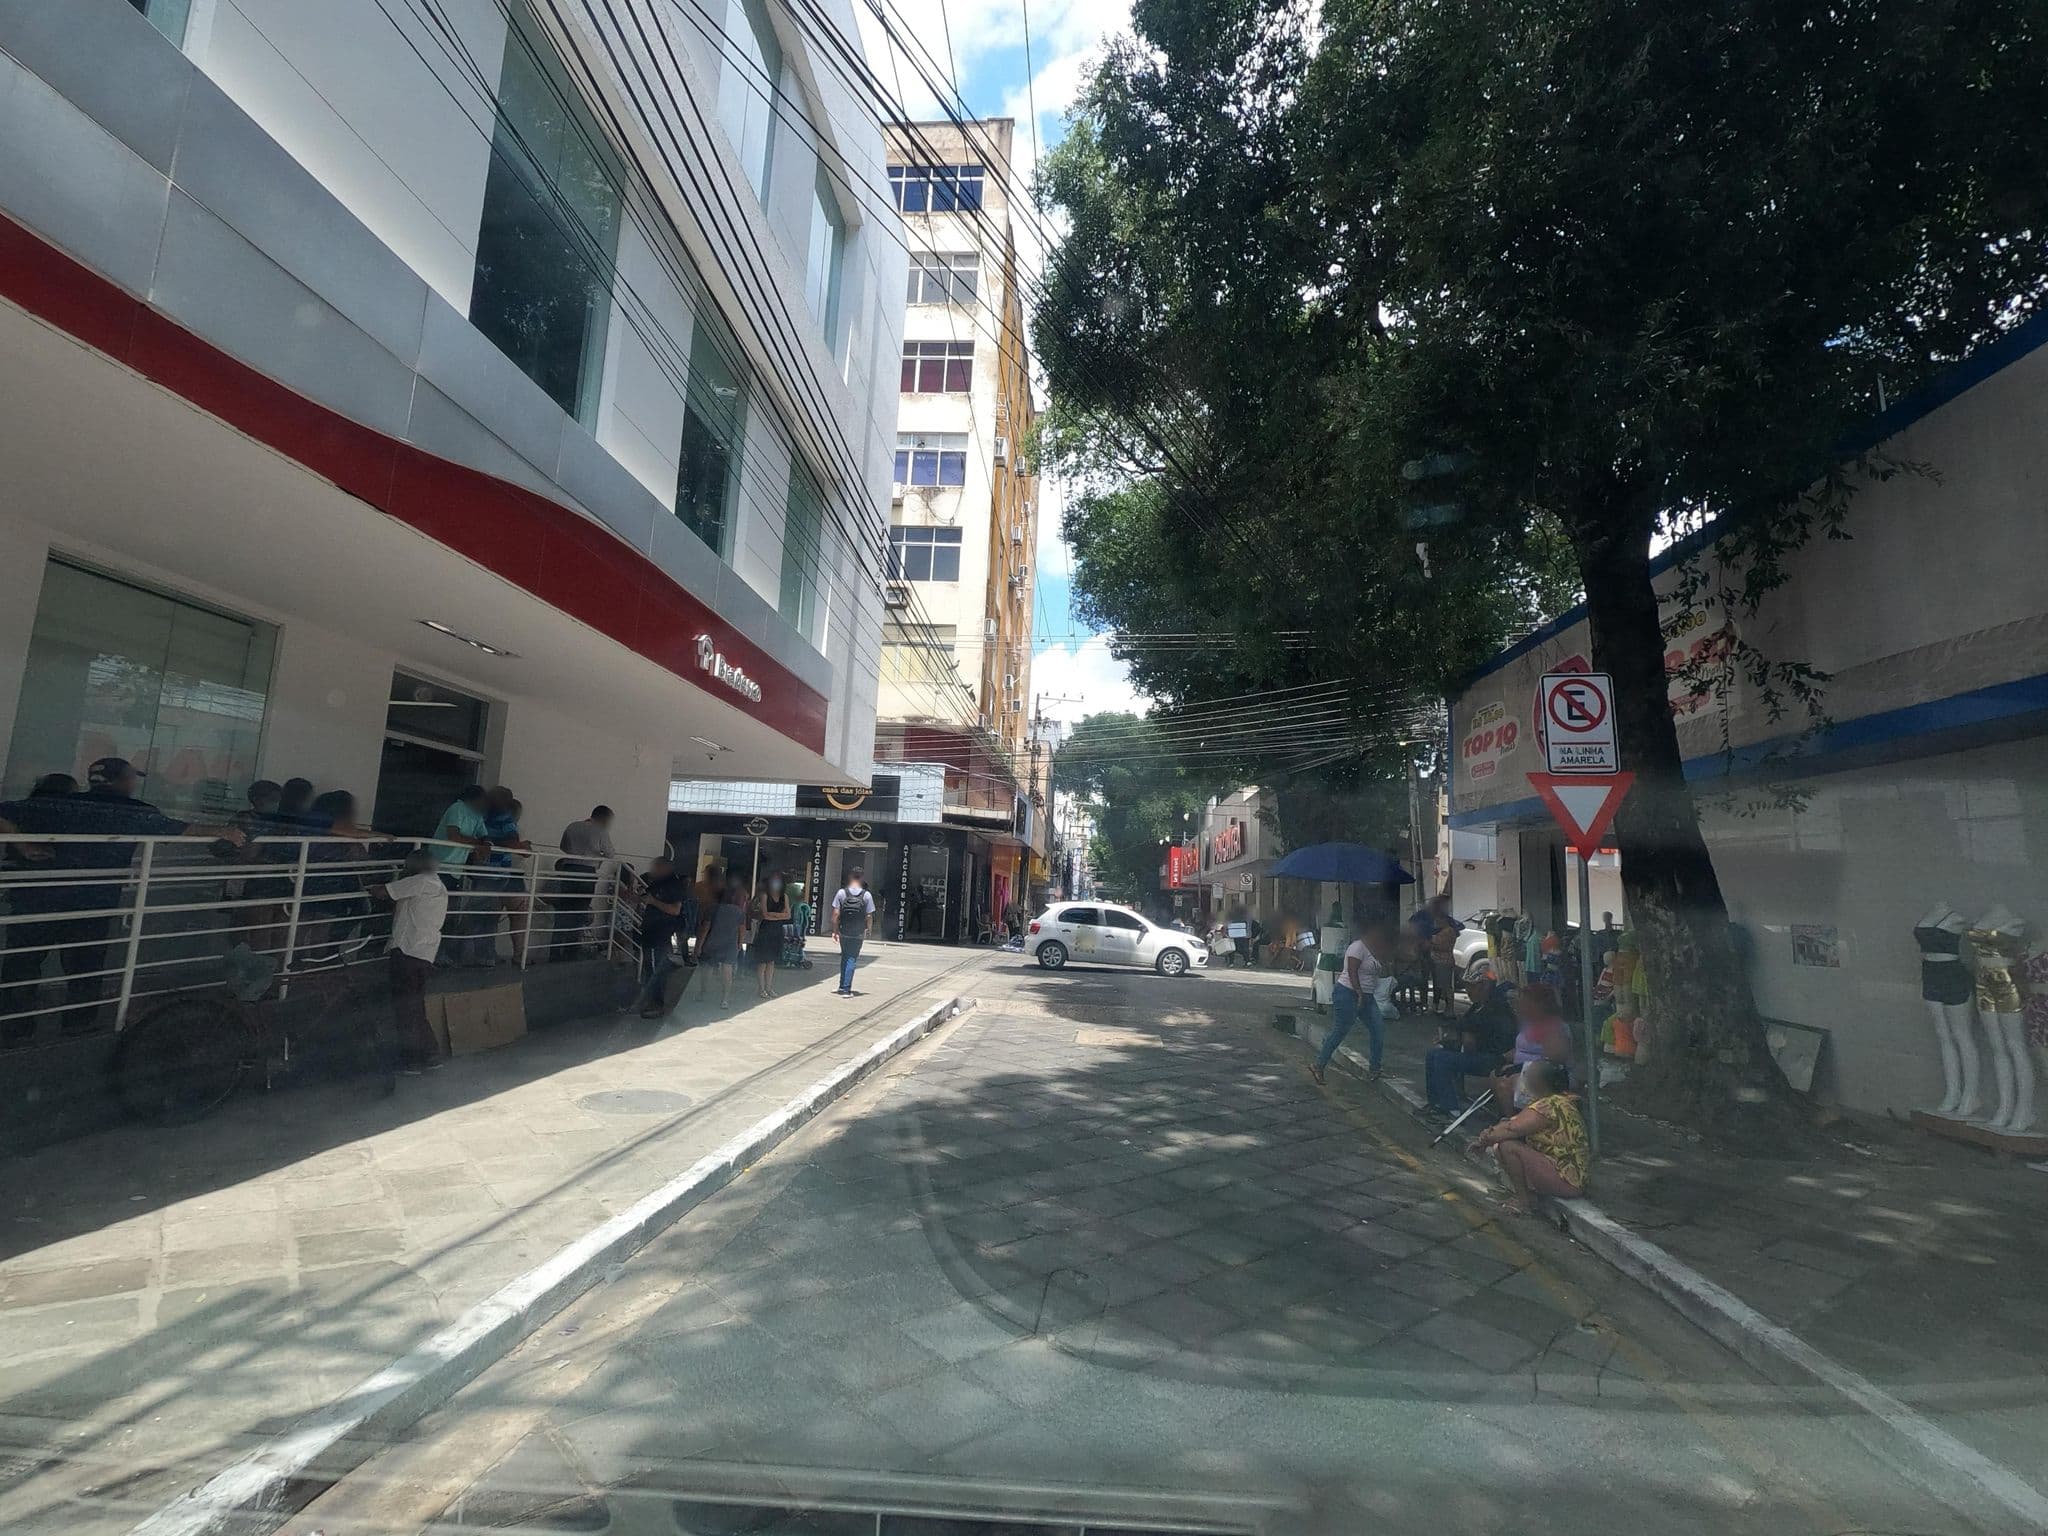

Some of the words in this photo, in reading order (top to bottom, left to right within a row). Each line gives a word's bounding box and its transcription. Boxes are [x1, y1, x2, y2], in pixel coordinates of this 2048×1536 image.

[714, 653, 762, 703] Bradesco
[1463, 730, 1495, 759] TOP
[1495, 720, 1518, 750] 10
[1560, 747, 1573, 755] NA
[1575, 746, 1605, 755] LINHA
[1560, 756, 1605, 765] AMARELA
[813, 838, 822, 885] ATACADO
[901, 844, 909, 890] ATACADO
[809, 895, 819, 935] VAREJO
[898, 900, 906, 940] VAREJO
